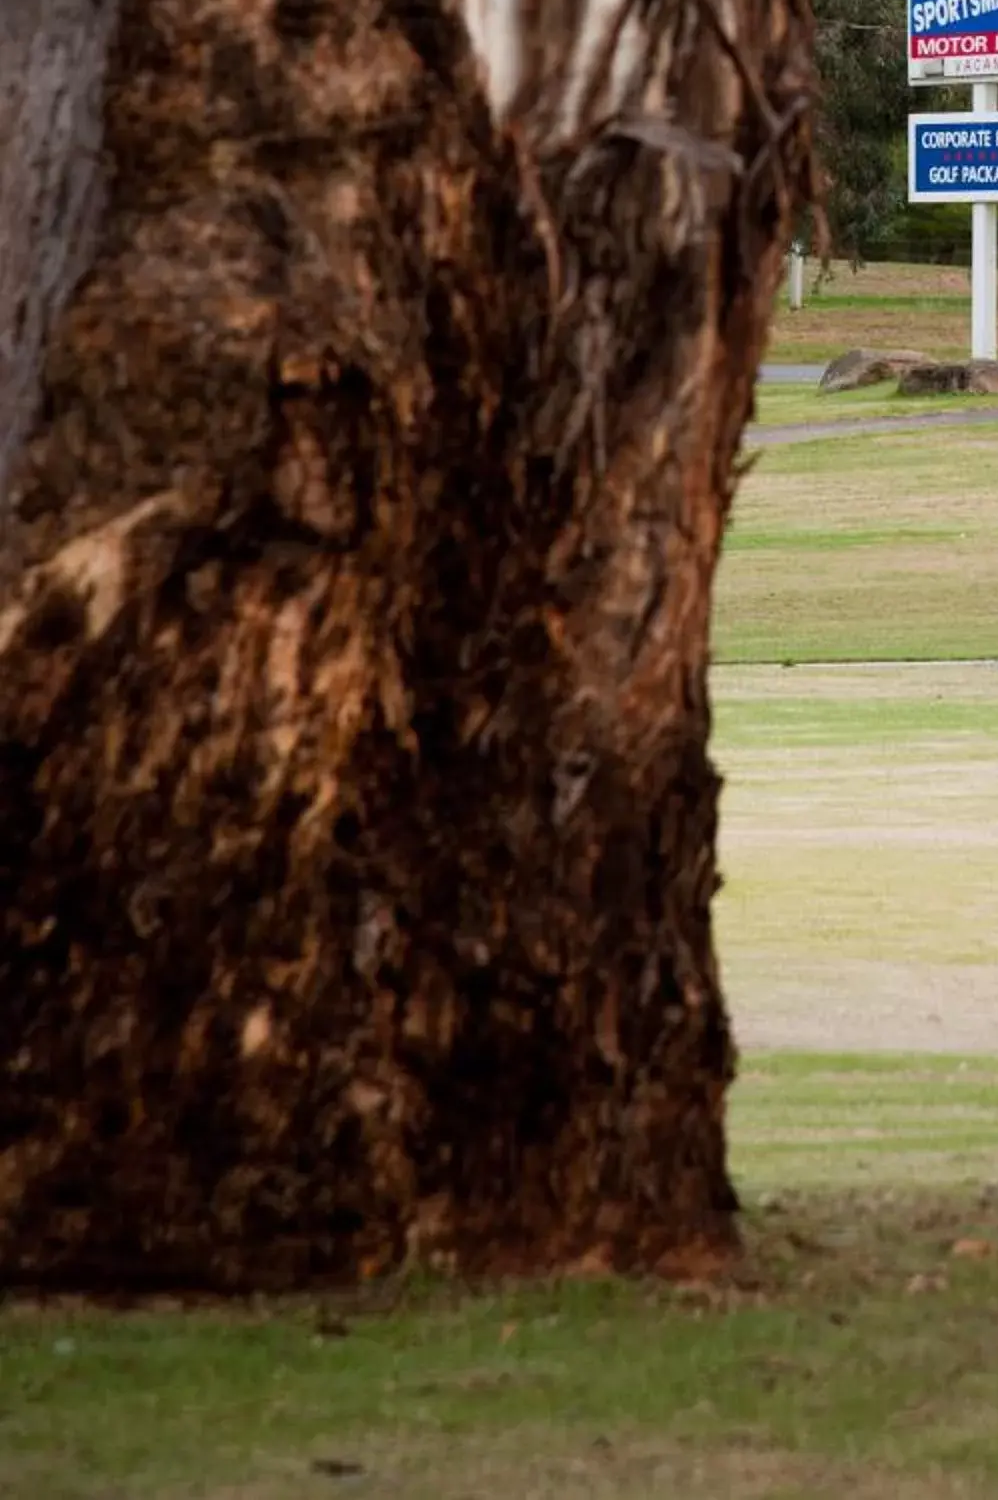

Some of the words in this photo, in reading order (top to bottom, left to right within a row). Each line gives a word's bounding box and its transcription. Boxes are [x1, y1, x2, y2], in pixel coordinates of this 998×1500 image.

[917, 35, 988, 55] MOTOR
[921, 130, 992, 148] CORPORATE
[929, 165, 959, 184] GOLF
